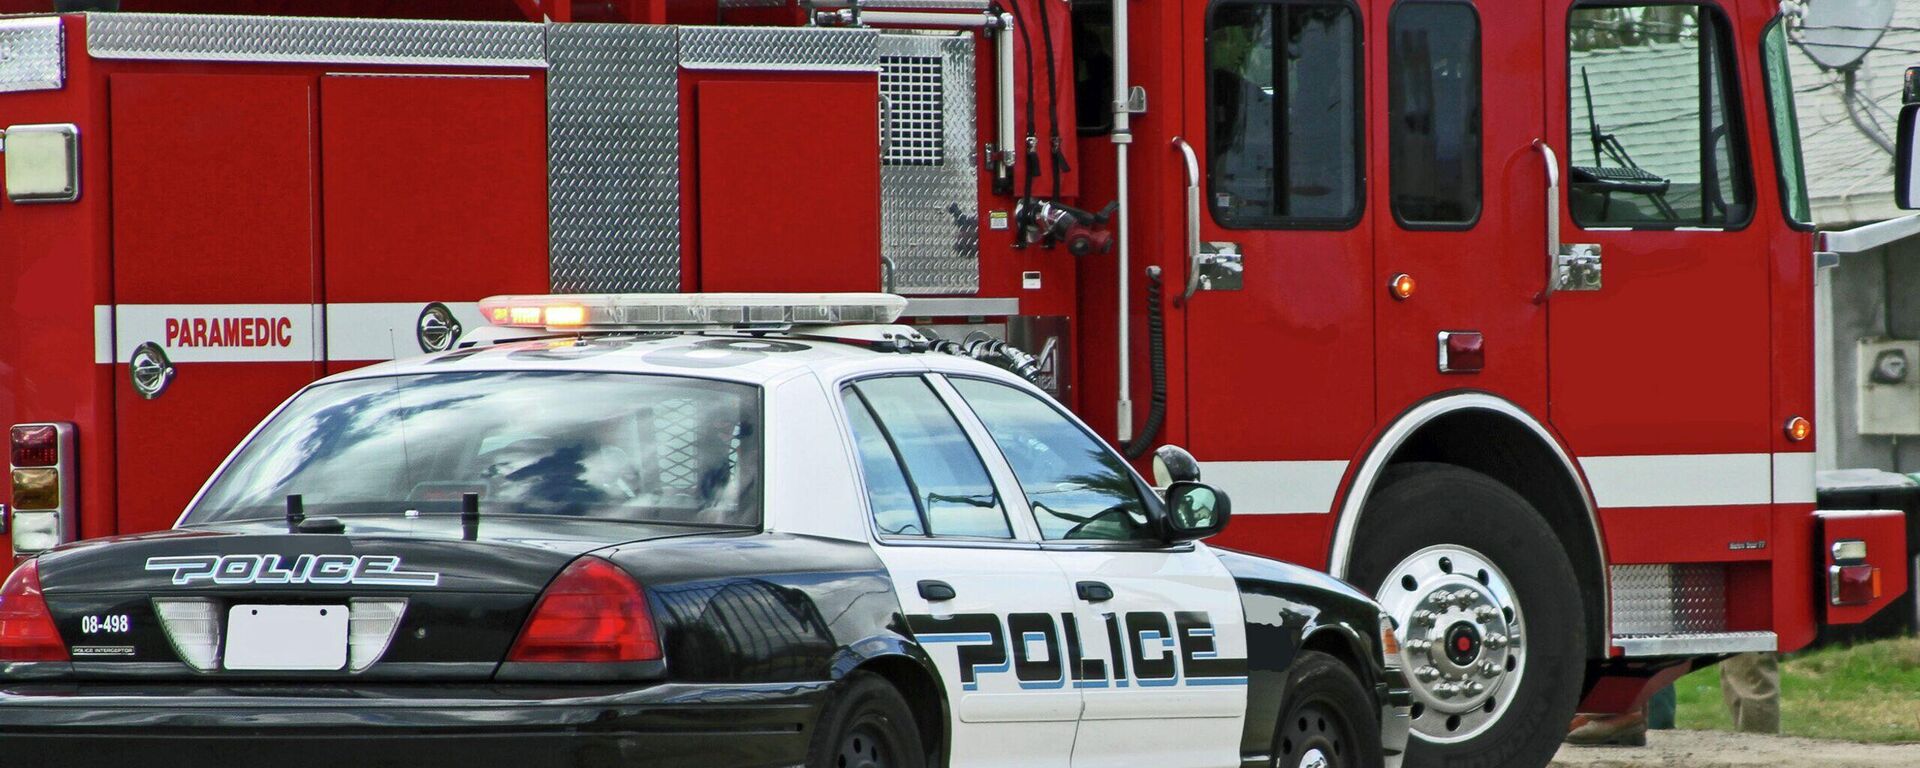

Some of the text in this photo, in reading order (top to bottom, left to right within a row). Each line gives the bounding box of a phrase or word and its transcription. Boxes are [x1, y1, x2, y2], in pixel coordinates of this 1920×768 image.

[165, 316, 292, 347] PARAMEDIC
[145, 554, 439, 585] POLICE
[81, 614, 129, 633] 08-498
[906, 611, 1248, 691] POLICE
